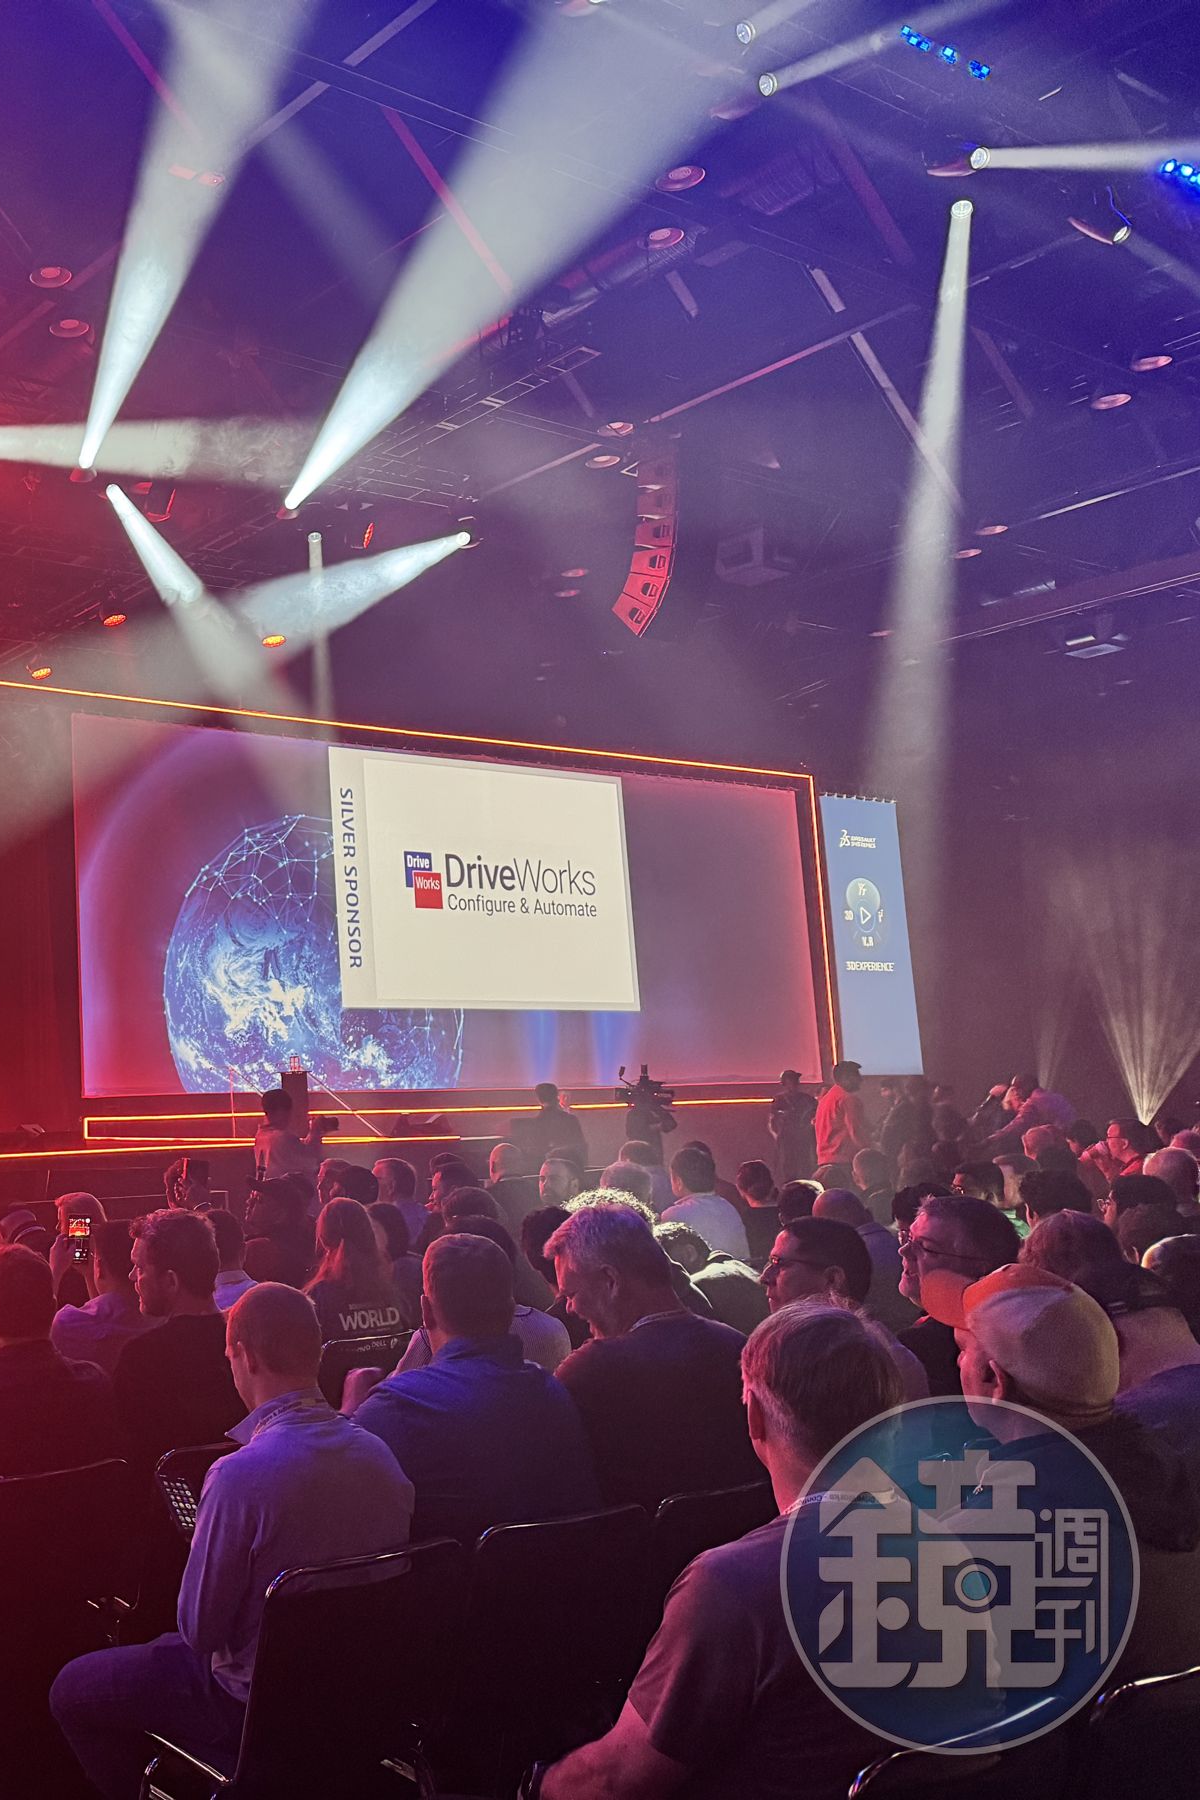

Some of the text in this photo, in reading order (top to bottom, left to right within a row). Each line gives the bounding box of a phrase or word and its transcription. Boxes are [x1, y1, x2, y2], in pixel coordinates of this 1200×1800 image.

[406, 854, 430, 869] Drive
[340, 788, 363, 968] SILVER SPONSOR
[415, 876, 441, 890] Works
[445, 853, 596, 896] DriveWorks
[447, 894, 598, 917] Configure & Automate
[339, 1307, 401, 1331] WORLD
